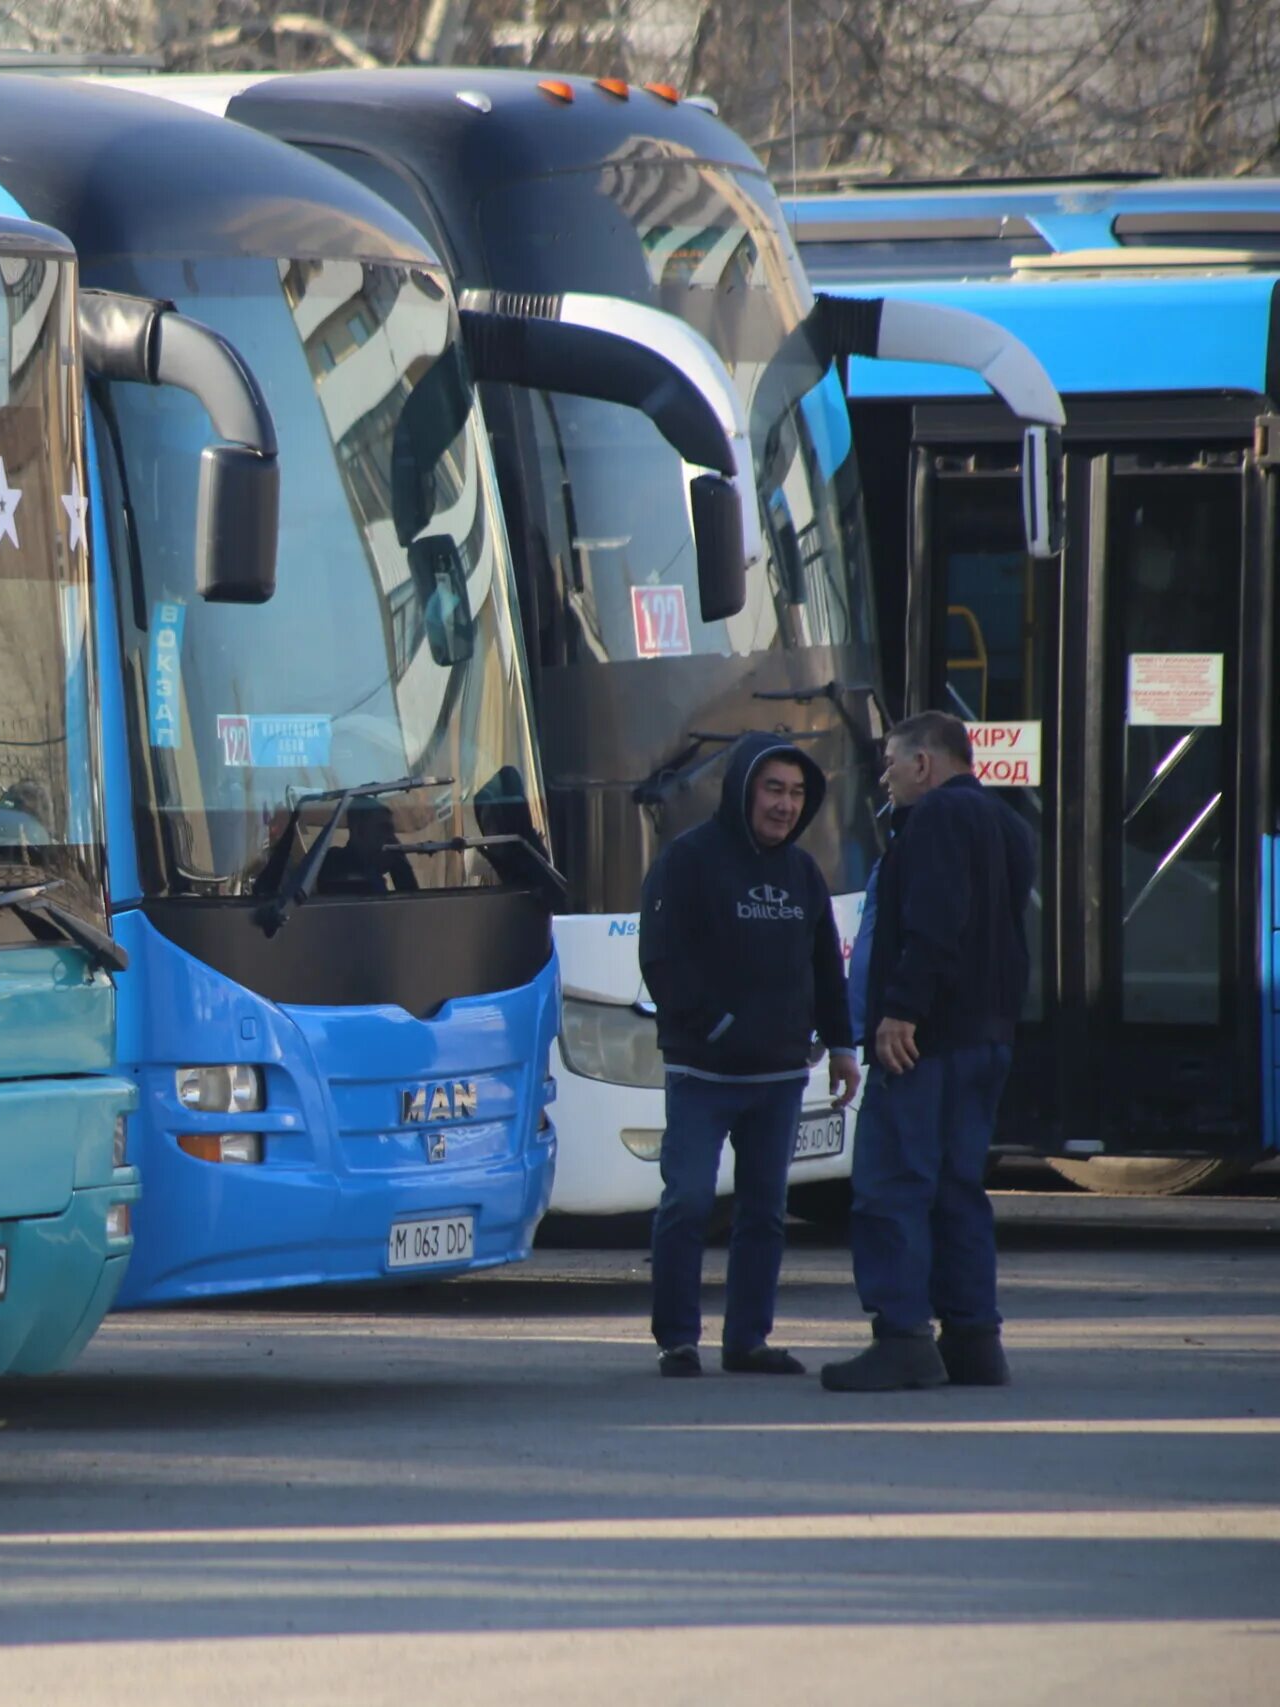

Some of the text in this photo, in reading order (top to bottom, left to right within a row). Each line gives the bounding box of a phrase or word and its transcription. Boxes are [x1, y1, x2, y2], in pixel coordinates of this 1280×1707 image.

[641, 594, 683, 649] 122
[223, 726, 250, 766] 122
[974, 760, 1029, 784] ХОД
[402, 1081, 478, 1124] MAN
[395, 1222, 468, 1261] M 063 DD
